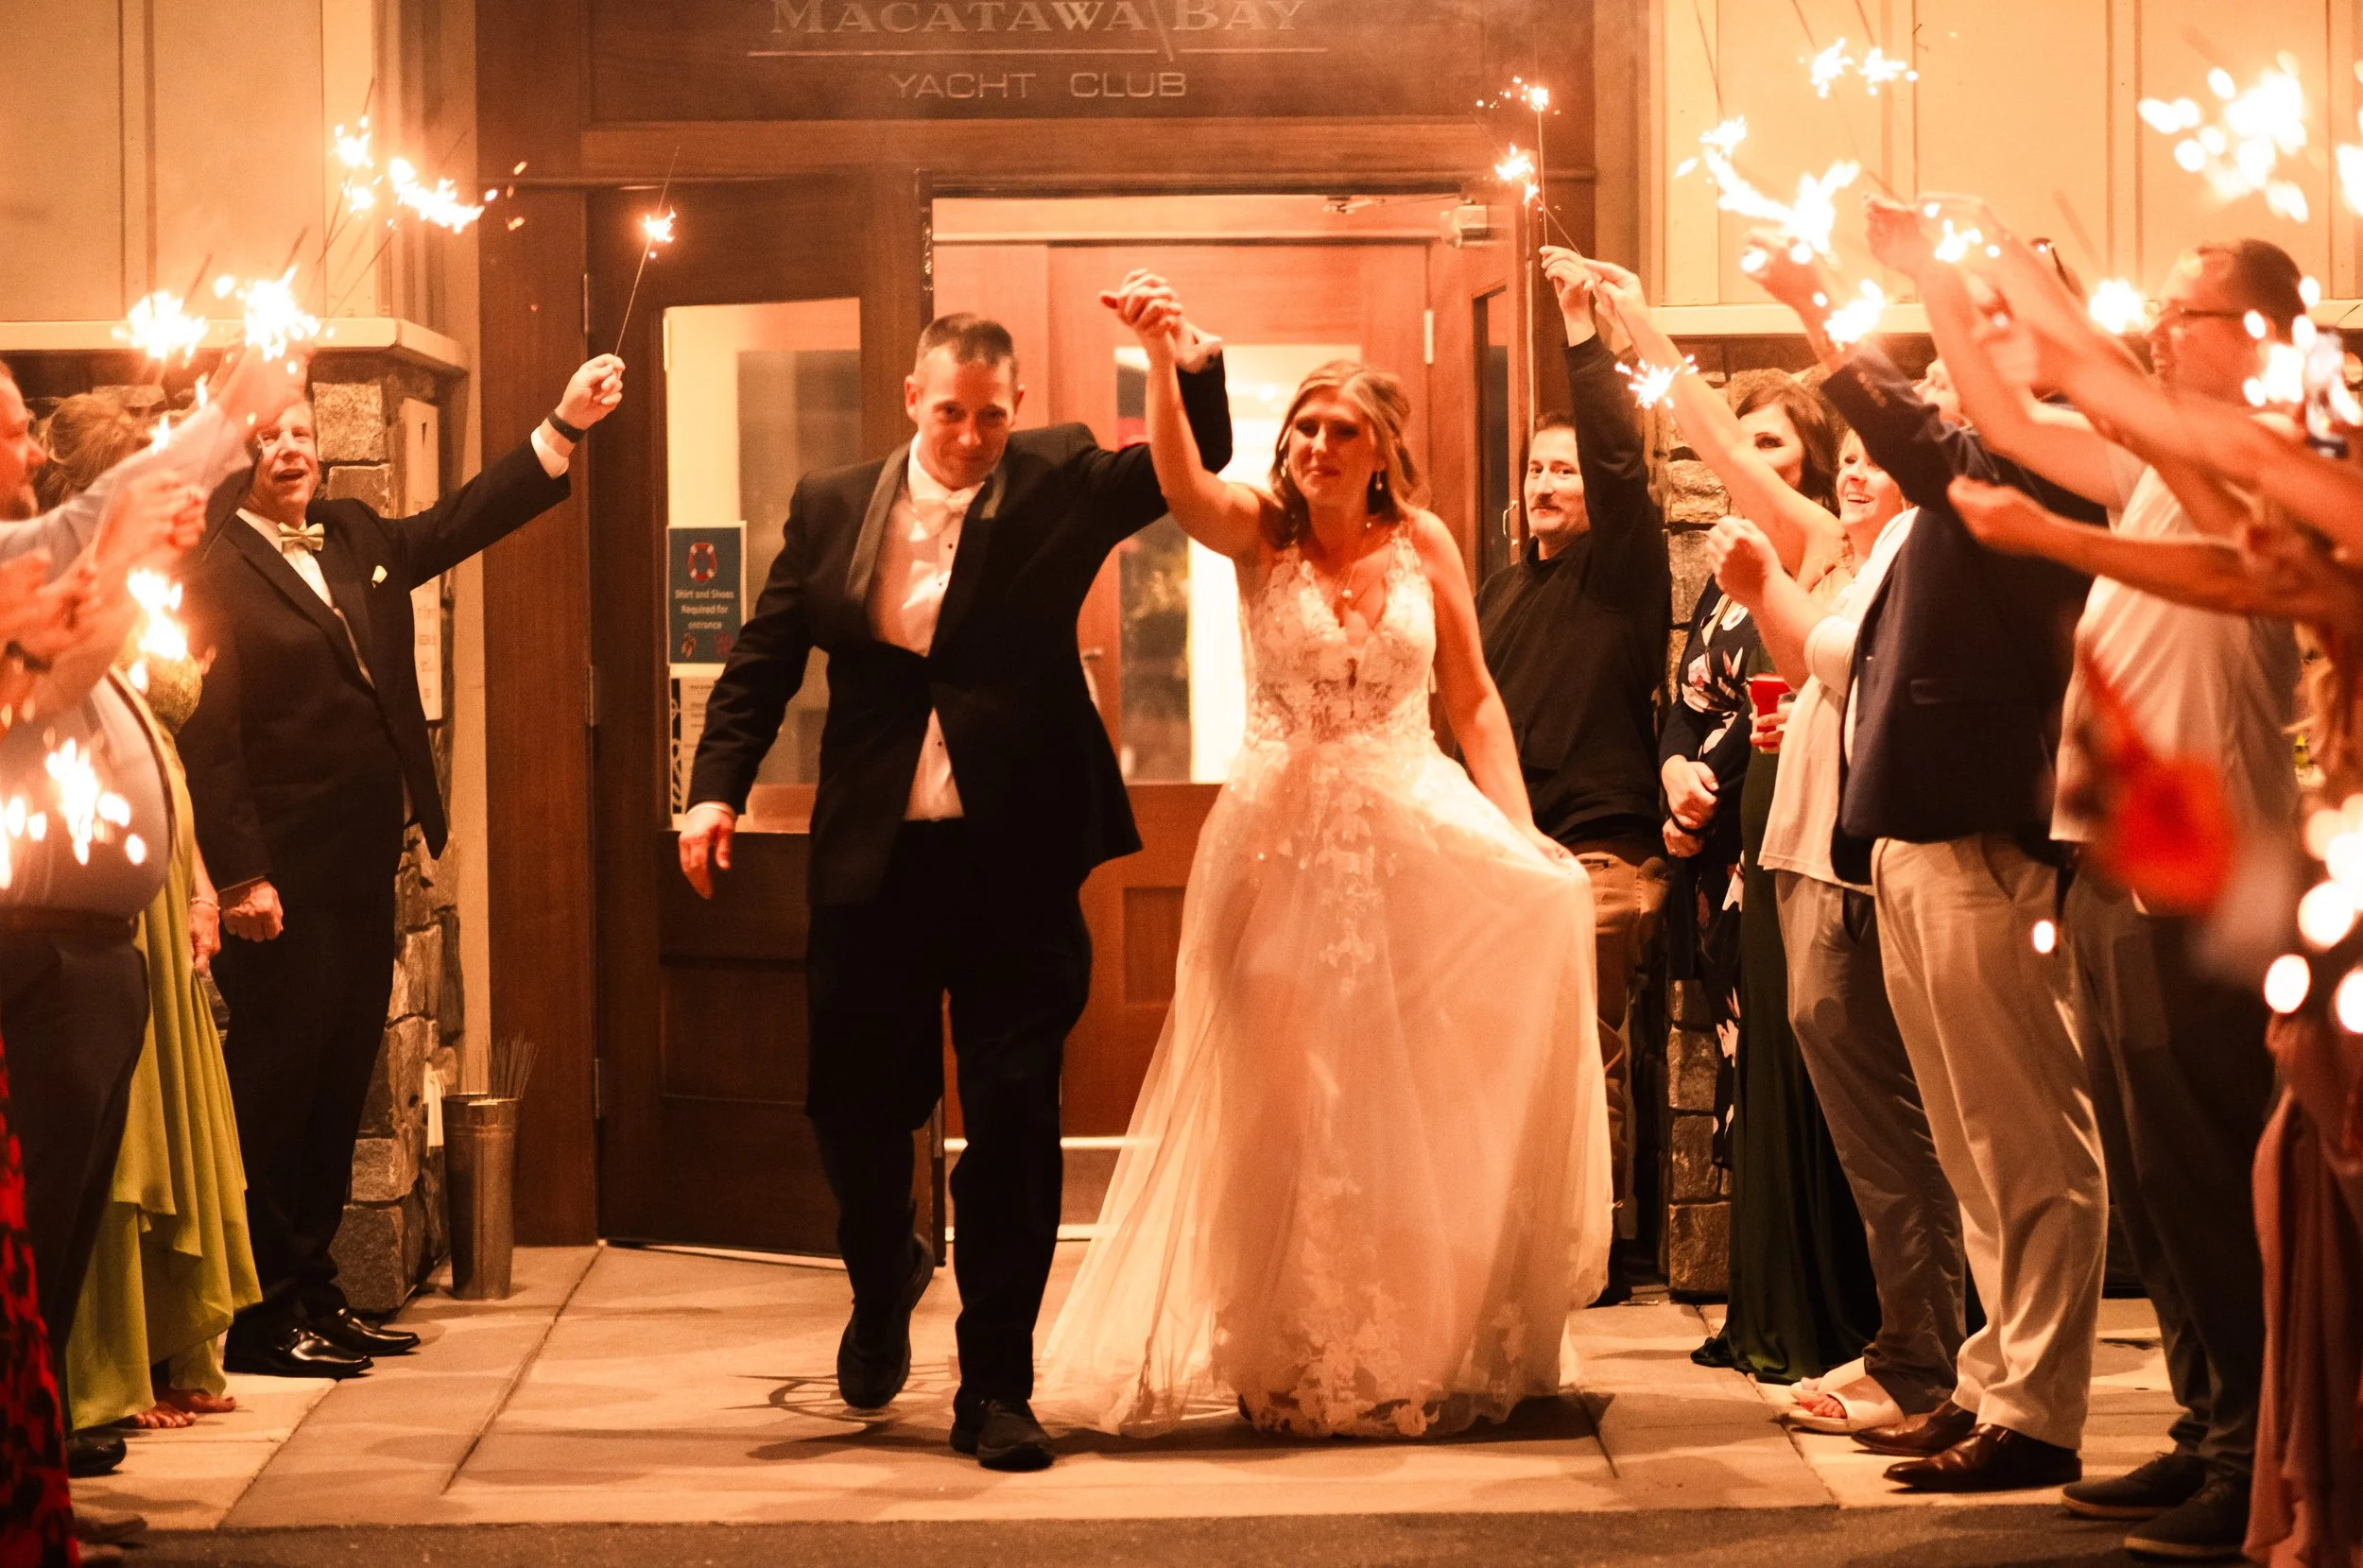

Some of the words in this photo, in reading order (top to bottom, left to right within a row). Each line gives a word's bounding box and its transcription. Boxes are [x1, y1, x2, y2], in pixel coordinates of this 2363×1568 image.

[770, 0, 1150, 34] MACATAWA
[1171, 0, 1305, 31] BAY
[888, 72, 1038, 99] YACHT
[1069, 71, 1187, 98] CLUB
[675, 589, 694, 599] Shirt
[695, 589, 710, 599] and
[711, 589, 734, 599] Shoes
[681, 604, 716, 615] Required
[716, 604, 729, 614] for
[688, 621, 723, 629] entrance
